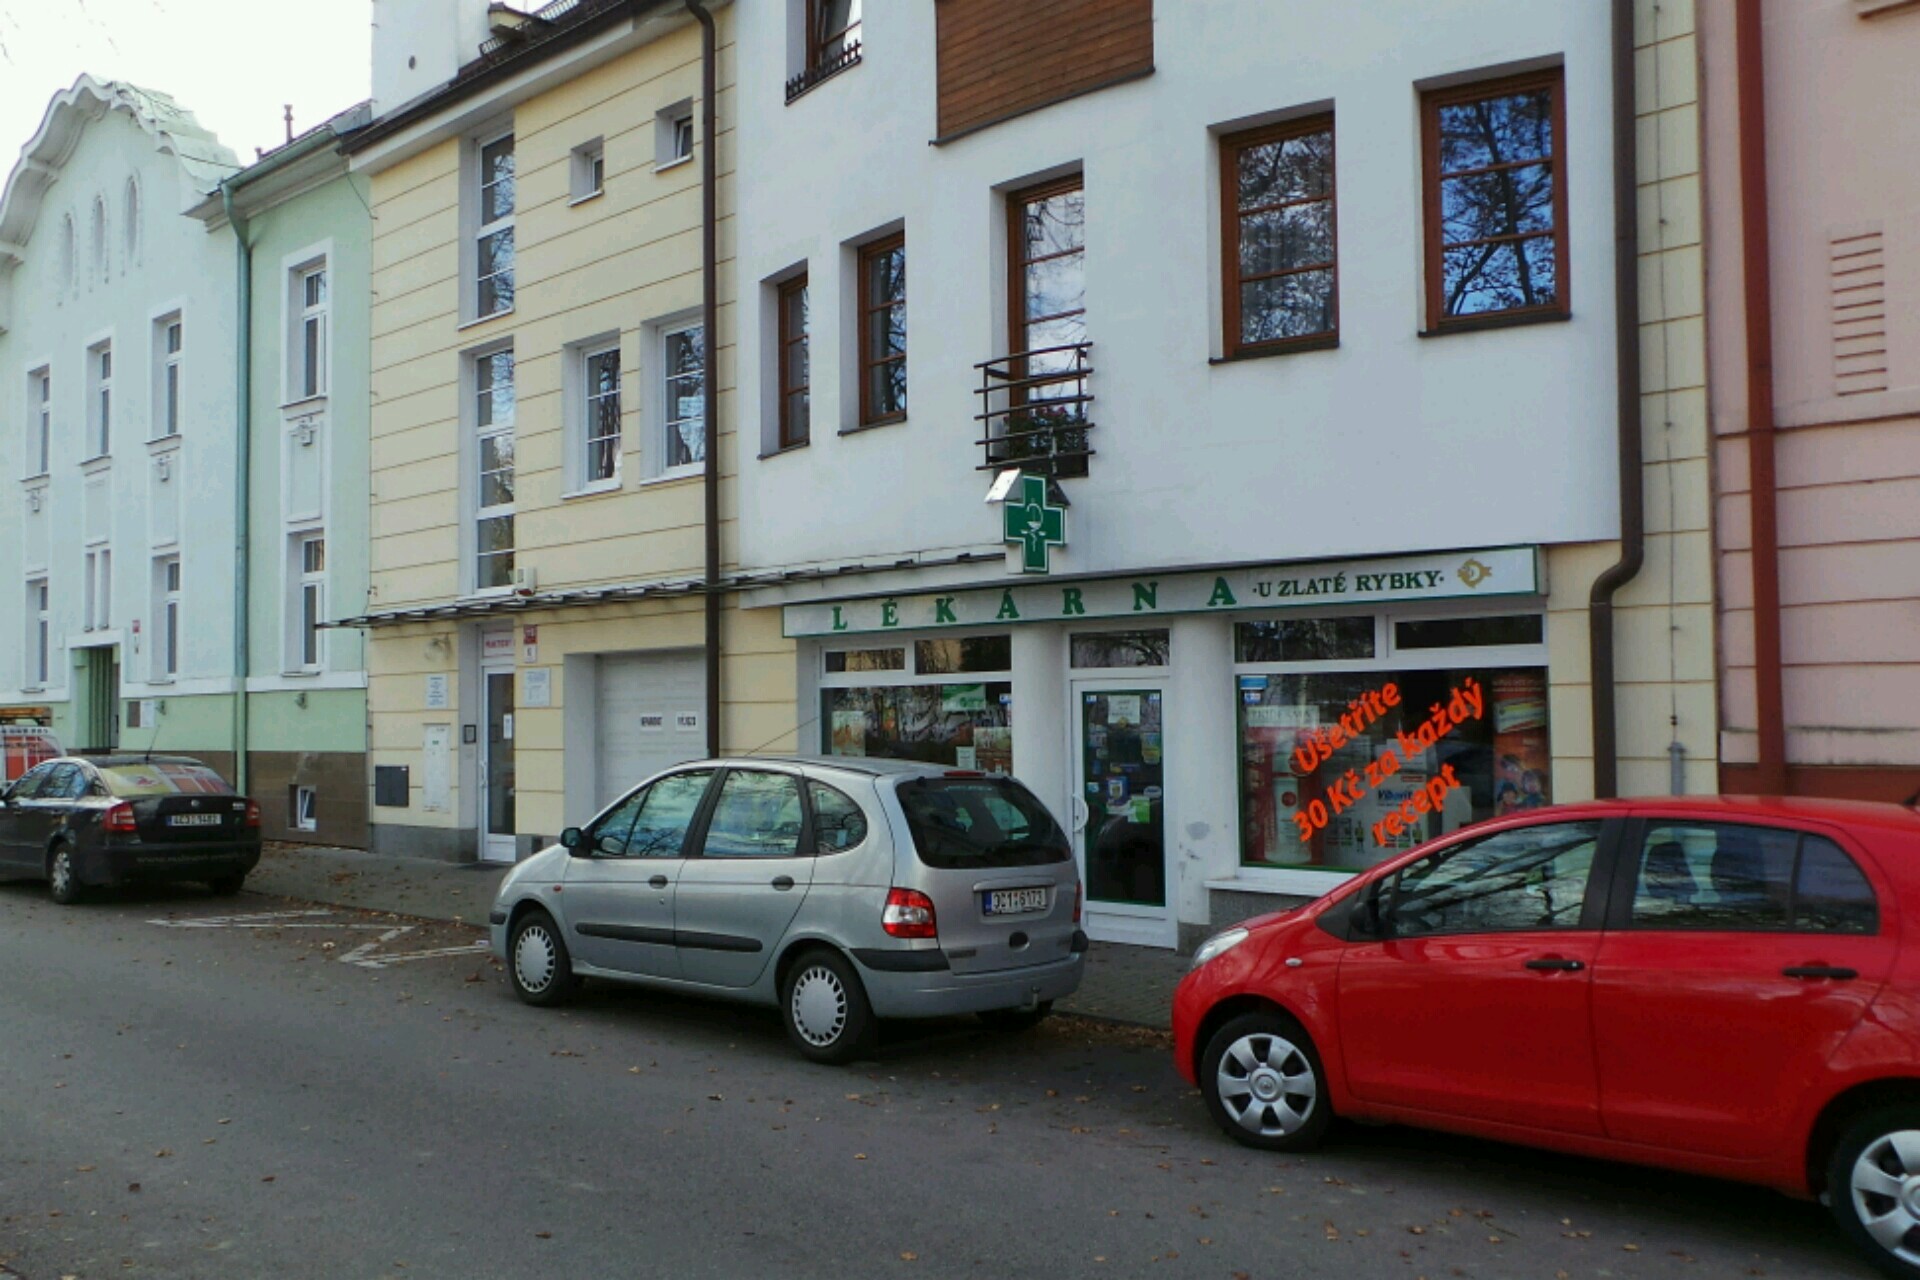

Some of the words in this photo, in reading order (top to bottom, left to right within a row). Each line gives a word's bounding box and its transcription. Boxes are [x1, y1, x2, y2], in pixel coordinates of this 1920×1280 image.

[832, 577, 1238, 631] LÉKÁRNA
[1257, 582, 1272, 597] U
[1278, 571, 1347, 597] ZLATÉ
[1355, 569, 1442, 592] RYBKY
[1292, 799, 1329, 842] 30
[1326, 768, 1366, 816] Kč
[1363, 750, 1401, 789] za
[1396, 676, 1484, 760] každý
[1295, 682, 1401, 772] Ušetříte
[1371, 763, 1460, 846] recept
